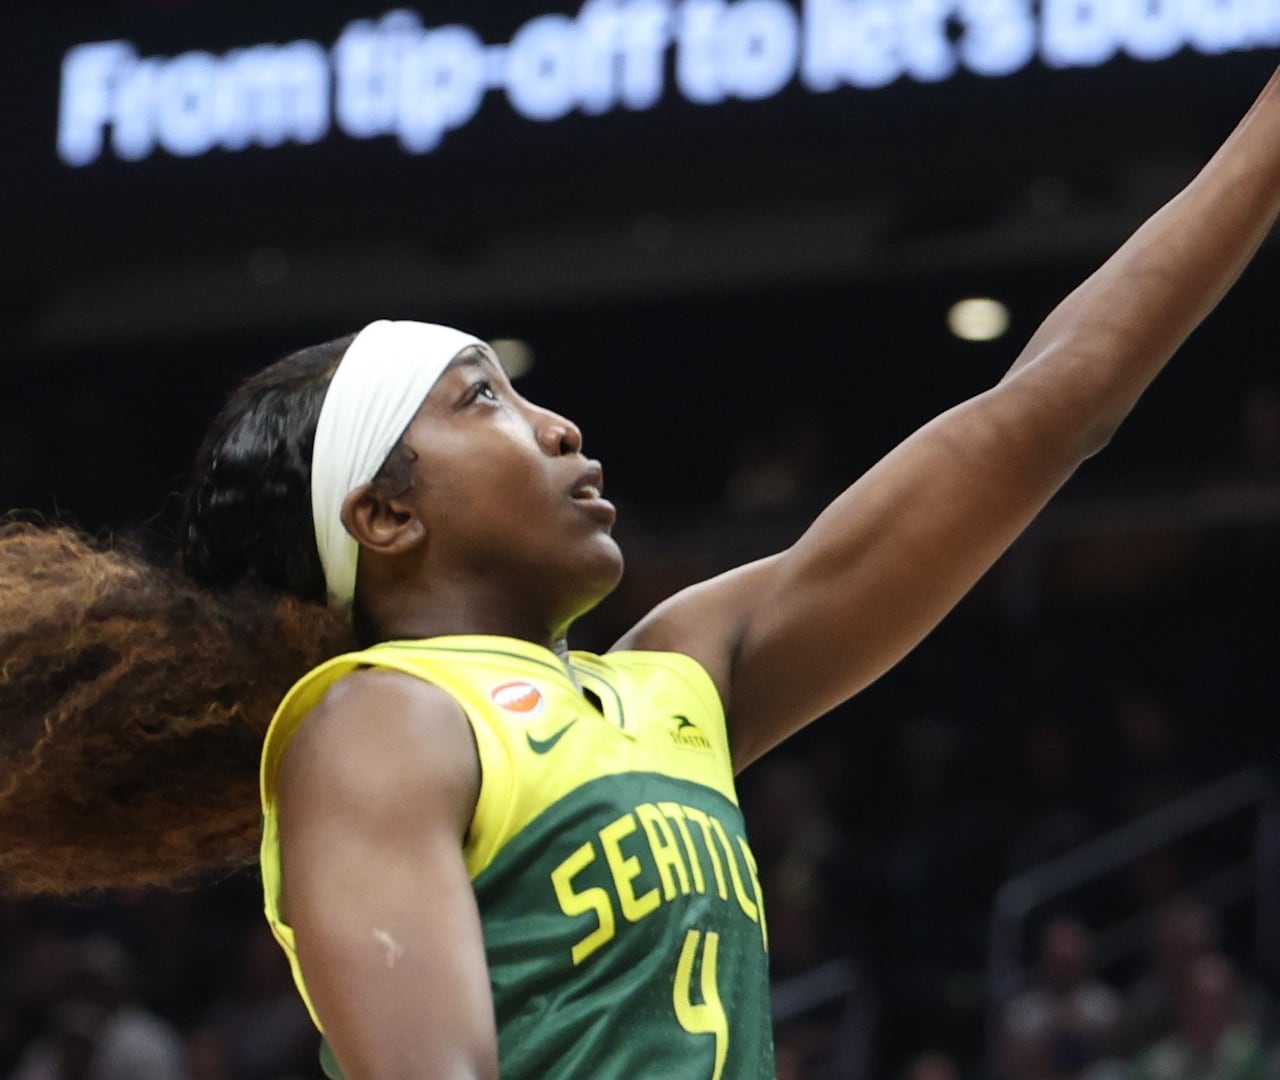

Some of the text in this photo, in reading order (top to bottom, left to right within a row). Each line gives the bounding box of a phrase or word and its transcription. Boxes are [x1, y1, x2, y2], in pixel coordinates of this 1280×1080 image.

[56, 38, 330, 168] From
[333, 0, 665, 154] tip-off
[670, 0, 798, 102] to
[801, 0, 1034, 92] let's
